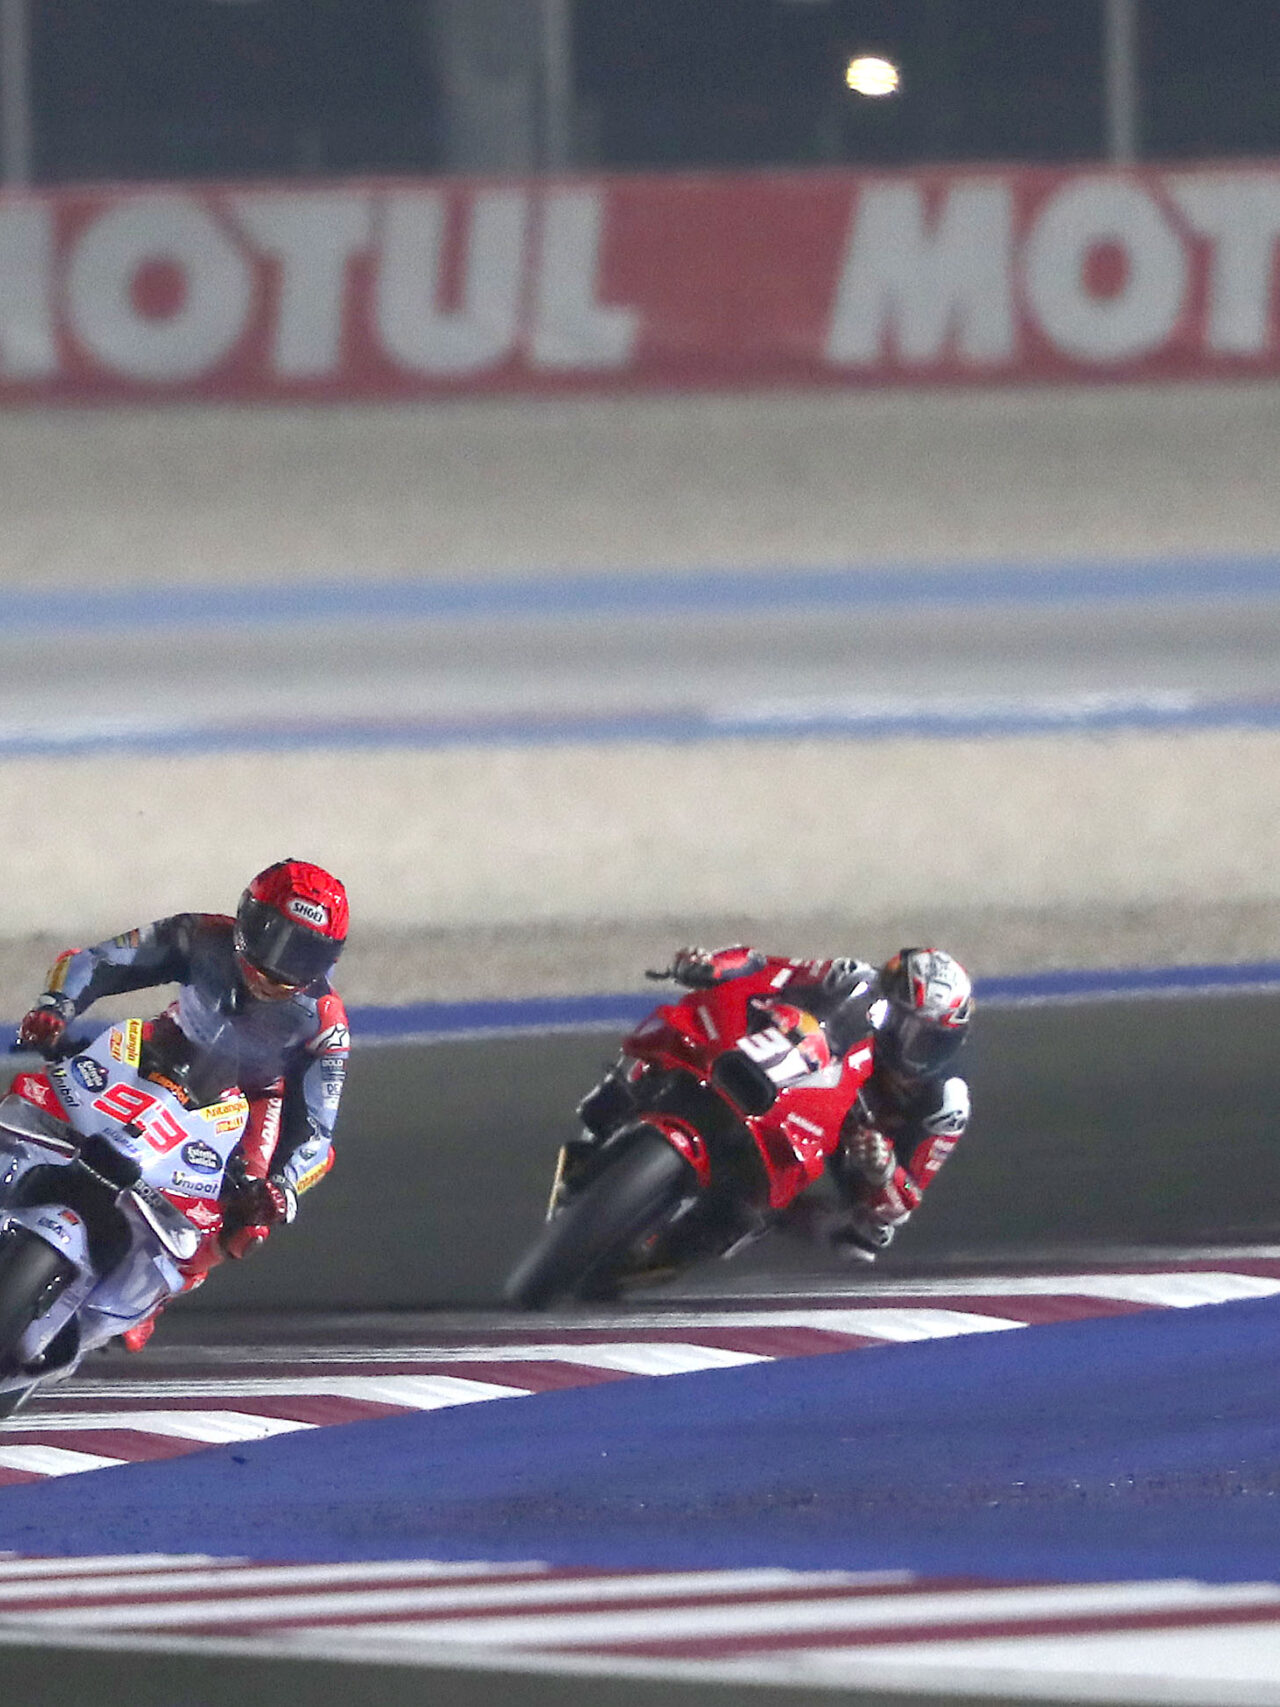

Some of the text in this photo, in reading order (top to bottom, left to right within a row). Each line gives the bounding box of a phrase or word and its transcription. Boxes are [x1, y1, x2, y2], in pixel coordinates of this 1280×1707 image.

[292, 902, 323, 922] SHOEI
[91, 1081, 189, 1155] 93
[172, 1171, 219, 1193] Unibat
